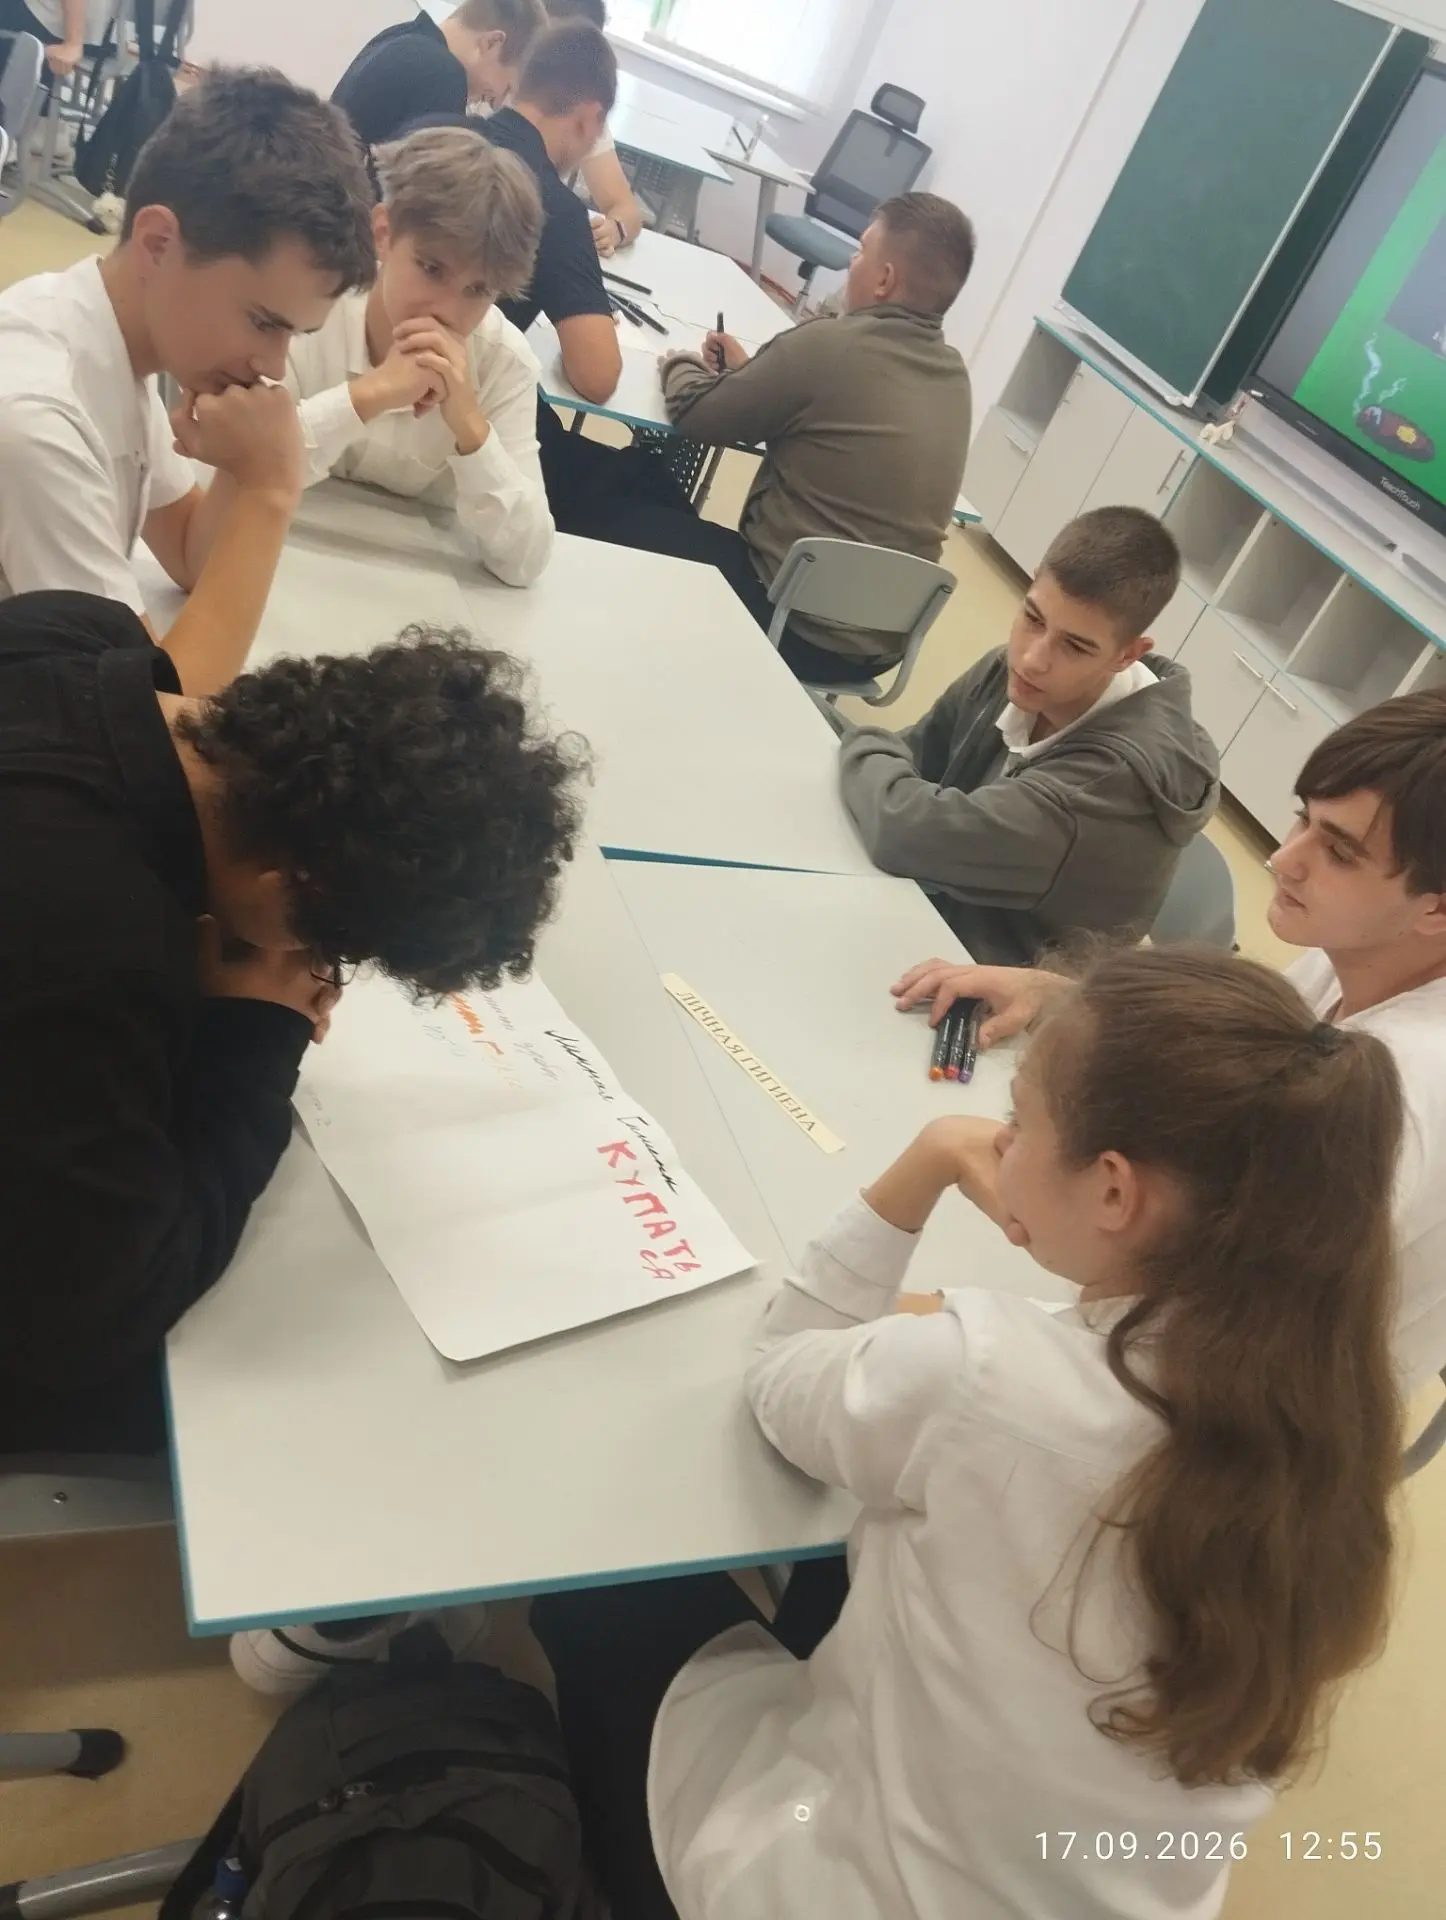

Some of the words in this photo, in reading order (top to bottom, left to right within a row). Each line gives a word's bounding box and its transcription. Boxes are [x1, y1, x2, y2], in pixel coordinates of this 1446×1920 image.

[676, 991, 744, 1054] ЛИЧНАЯ
[740, 1056, 816, 1132] ГИГИЕНА
[596, 1140, 702, 1272] КУПАТЬ
